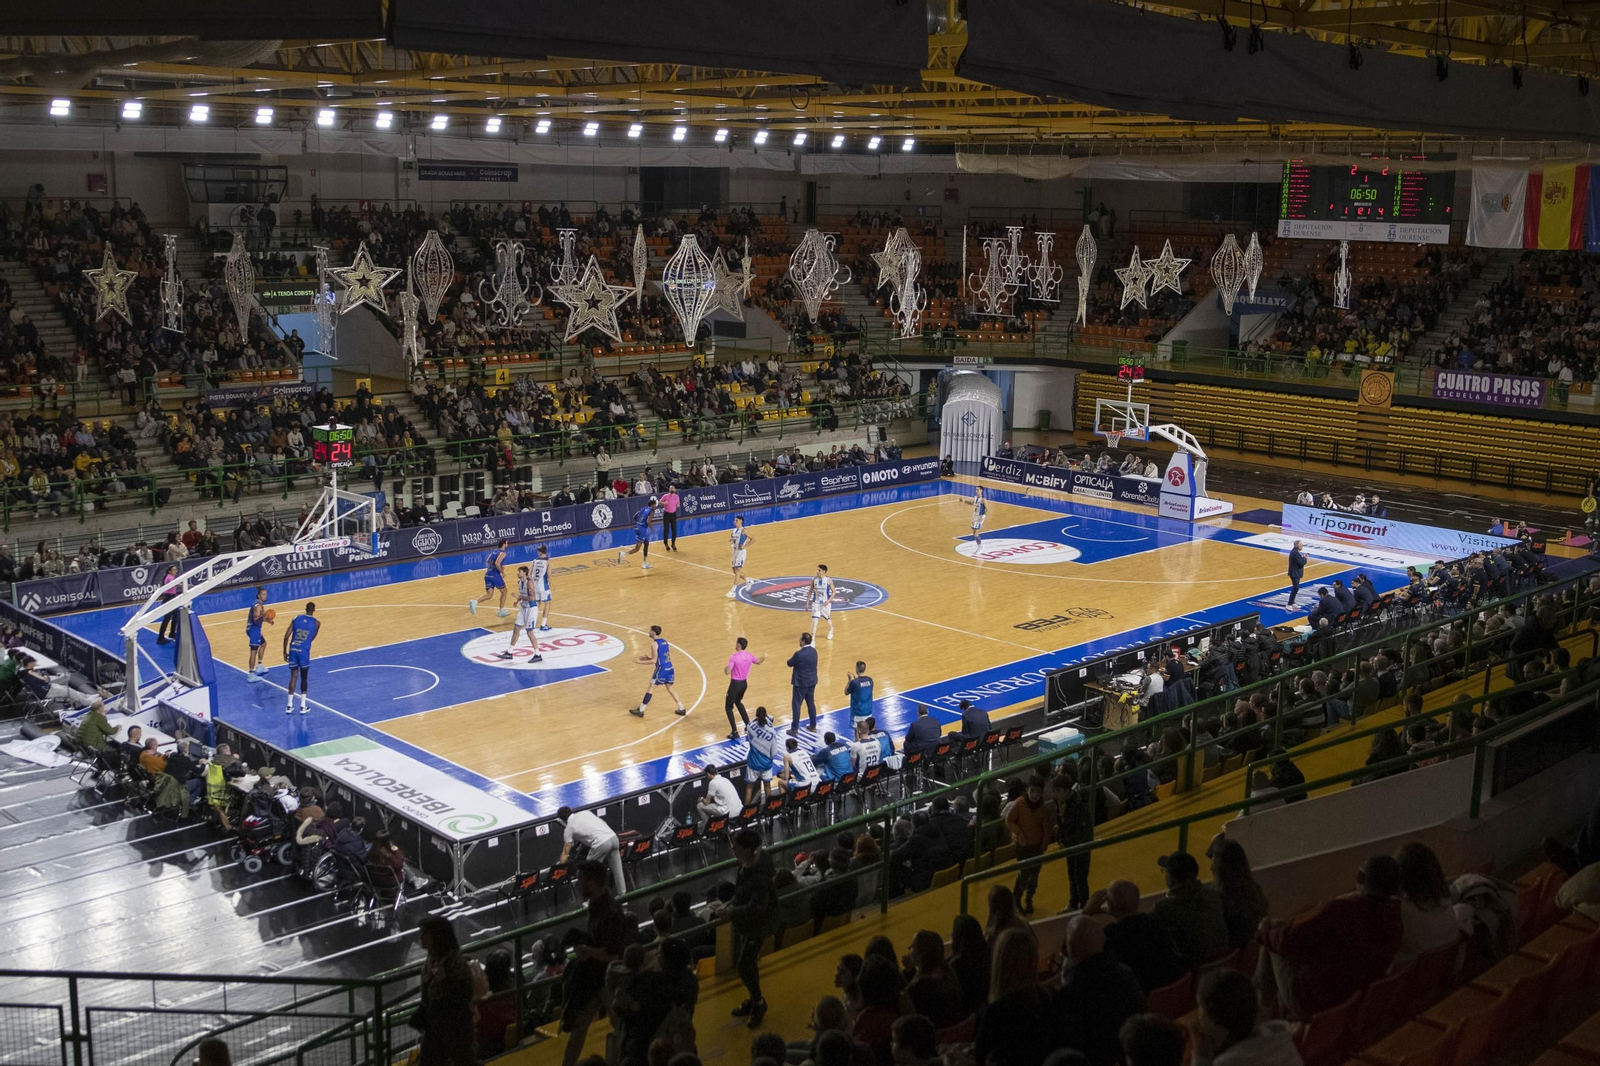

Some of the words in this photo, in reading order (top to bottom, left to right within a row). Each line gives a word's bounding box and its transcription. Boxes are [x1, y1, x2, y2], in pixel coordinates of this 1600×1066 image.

[479, 169, 512, 178] Coinscrap
[1350, 188, 1378, 200] 06:50
[63, 199, 71, 211] 3
[362, 202, 369, 212] 4
[1293, 223, 1334, 231] DEPUTACIÓN
[955, 356, 977, 364] SAIDA
[499, 371, 506, 382] 4
[1119, 365, 1133, 379] 24
[272, 383, 312, 395] Coinscrap
[1437, 372, 1490, 393] CUATRO
[1493, 378, 1541, 398] PASOS
[1436, 389, 1481, 400] ESCUELA
[1486, 394, 1499, 402] DE
[1505, 396, 1540, 406] DANZA
[329, 429, 353, 441] 06:50
[314, 441, 328, 460] 24
[330, 442, 352, 463] 24
[912, 461, 939, 472] HYUNDAI
[870, 468, 899, 483] MOTO
[700, 502, 713, 510] low
[713, 501, 727, 509] cost
[1198, 505, 1223, 514] BricoCentro
[523, 526, 542, 537] Alán
[542, 521, 573, 534] Penedo
[1308, 513, 1388, 537] tripomant
[461, 531, 483, 546] pazo
[498, 527, 516, 538] mar
[306, 540, 341, 551] BricoCentro
[535, 568, 541, 578] 2
[123, 584, 161, 598] ORVION
[44, 591, 97, 605] XURISGAL
[1012, 614, 1072, 631] FEB
[803, 760, 815, 773] 13
[865, 754, 878, 767] 22
[333, 757, 456, 815] IBEREÓLICA
[402, 805, 430, 819] GRUPO
